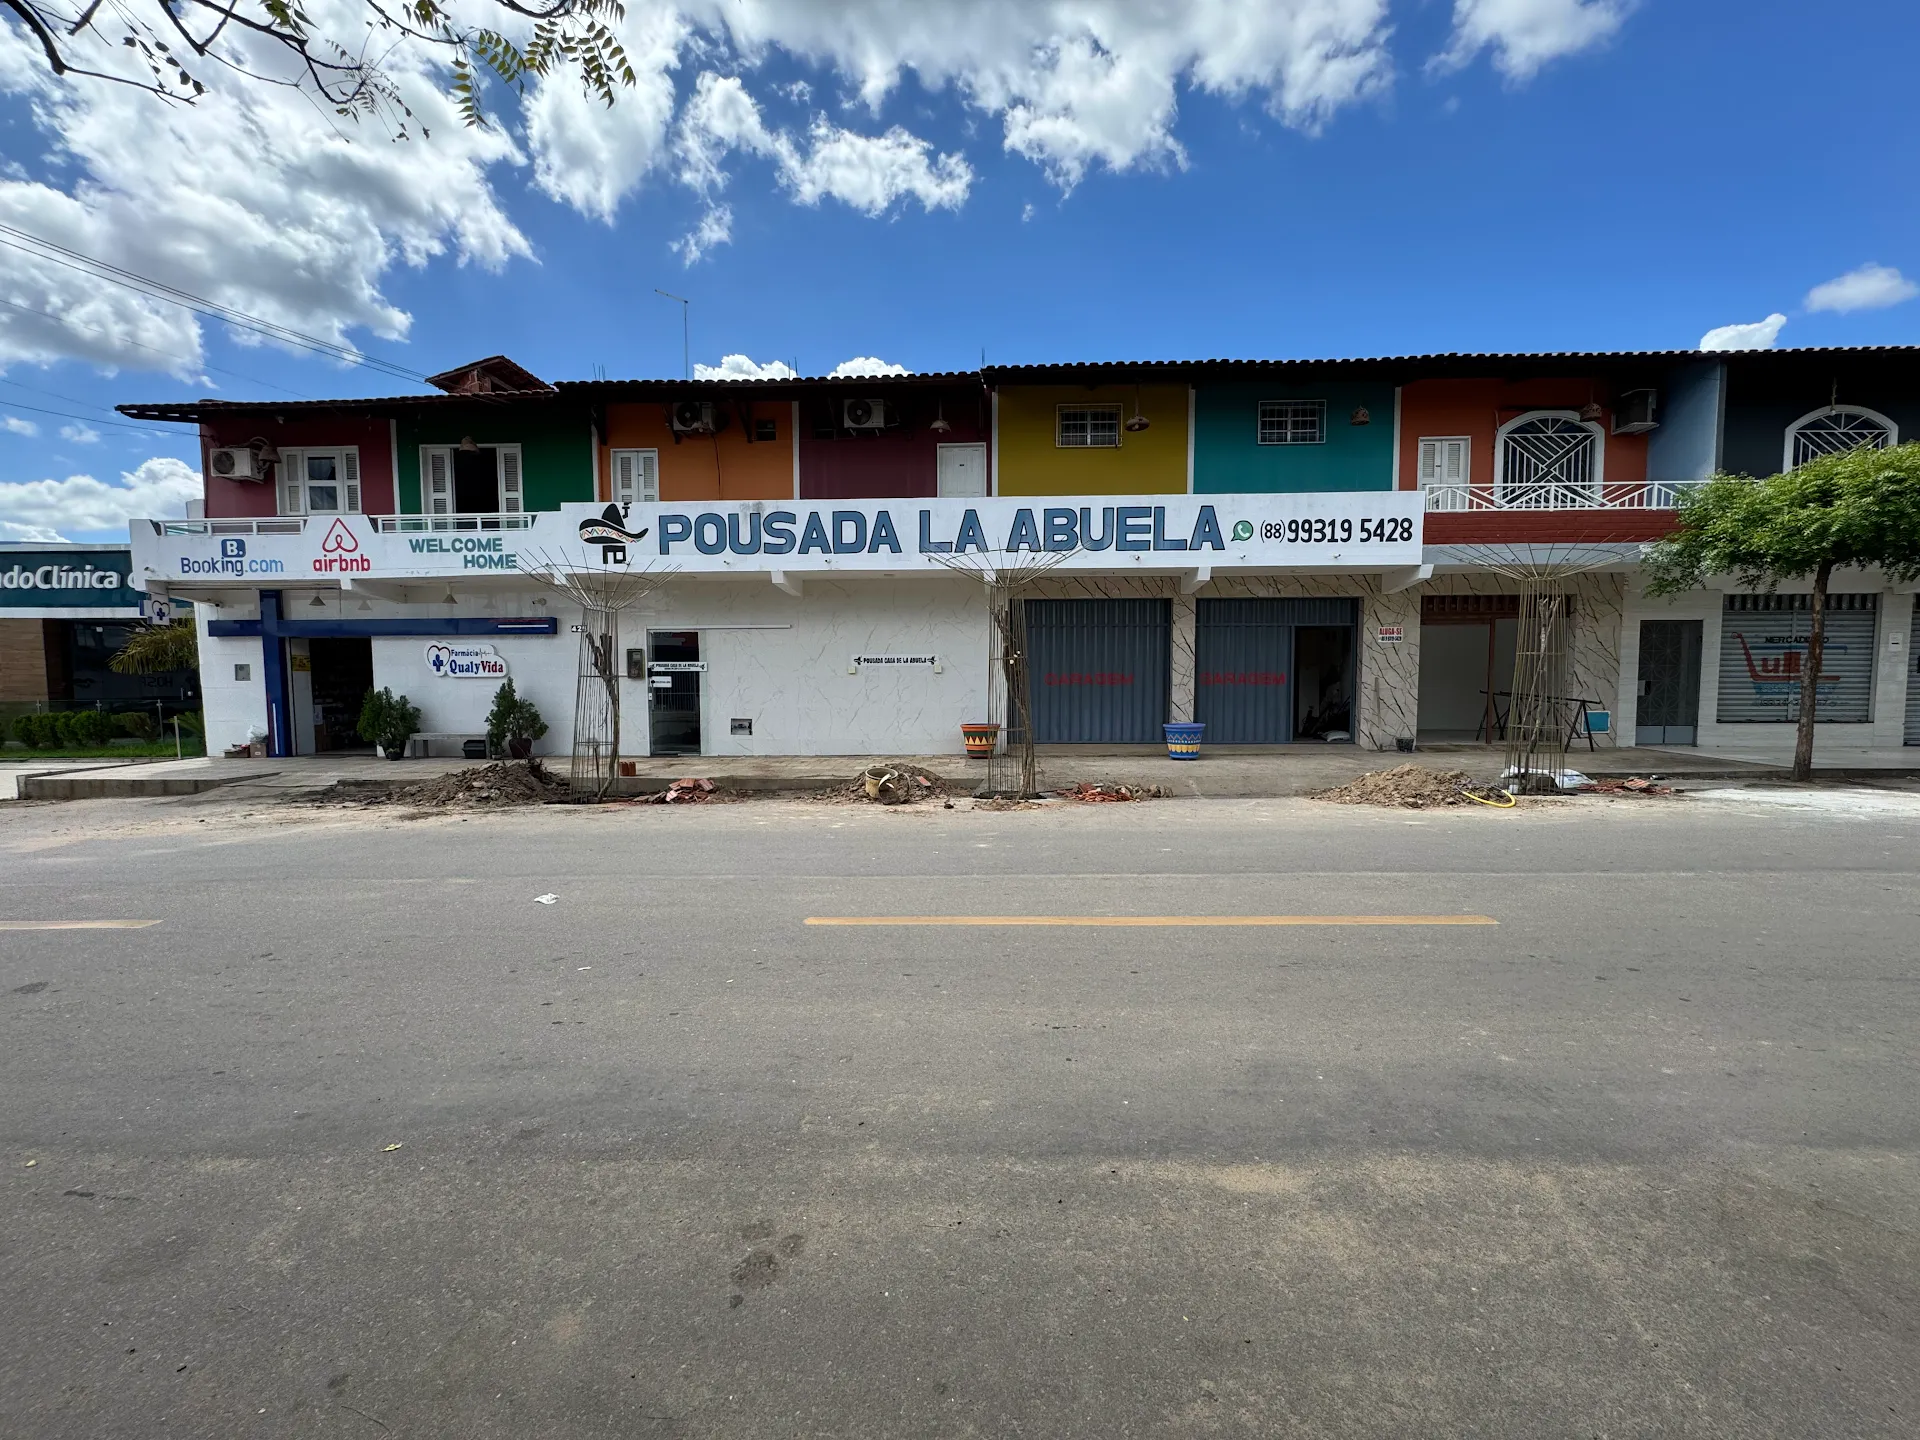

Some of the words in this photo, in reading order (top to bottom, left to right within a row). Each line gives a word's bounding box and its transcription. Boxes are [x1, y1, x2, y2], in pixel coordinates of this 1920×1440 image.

[658, 510, 903, 555] POUSADA
[918, 508, 989, 554] LA
[1005, 505, 1226, 553] ABUELA
[1287, 518, 1353, 543] 99319
[1359, 517, 1413, 543] 5428
[408, 537, 503, 553] WELCOME
[180, 556, 284, 577] Booking.com
[312, 553, 371, 572] airbnb
[463, 553, 517, 569] HOME
[0, 564, 120, 590] doClínica
[450, 648, 479, 657] Farmácia
[449, 659, 504, 675] QualyVida
[1044, 672, 1135, 686] GARAGEM
[1200, 671, 1287, 686] GARAGEM
